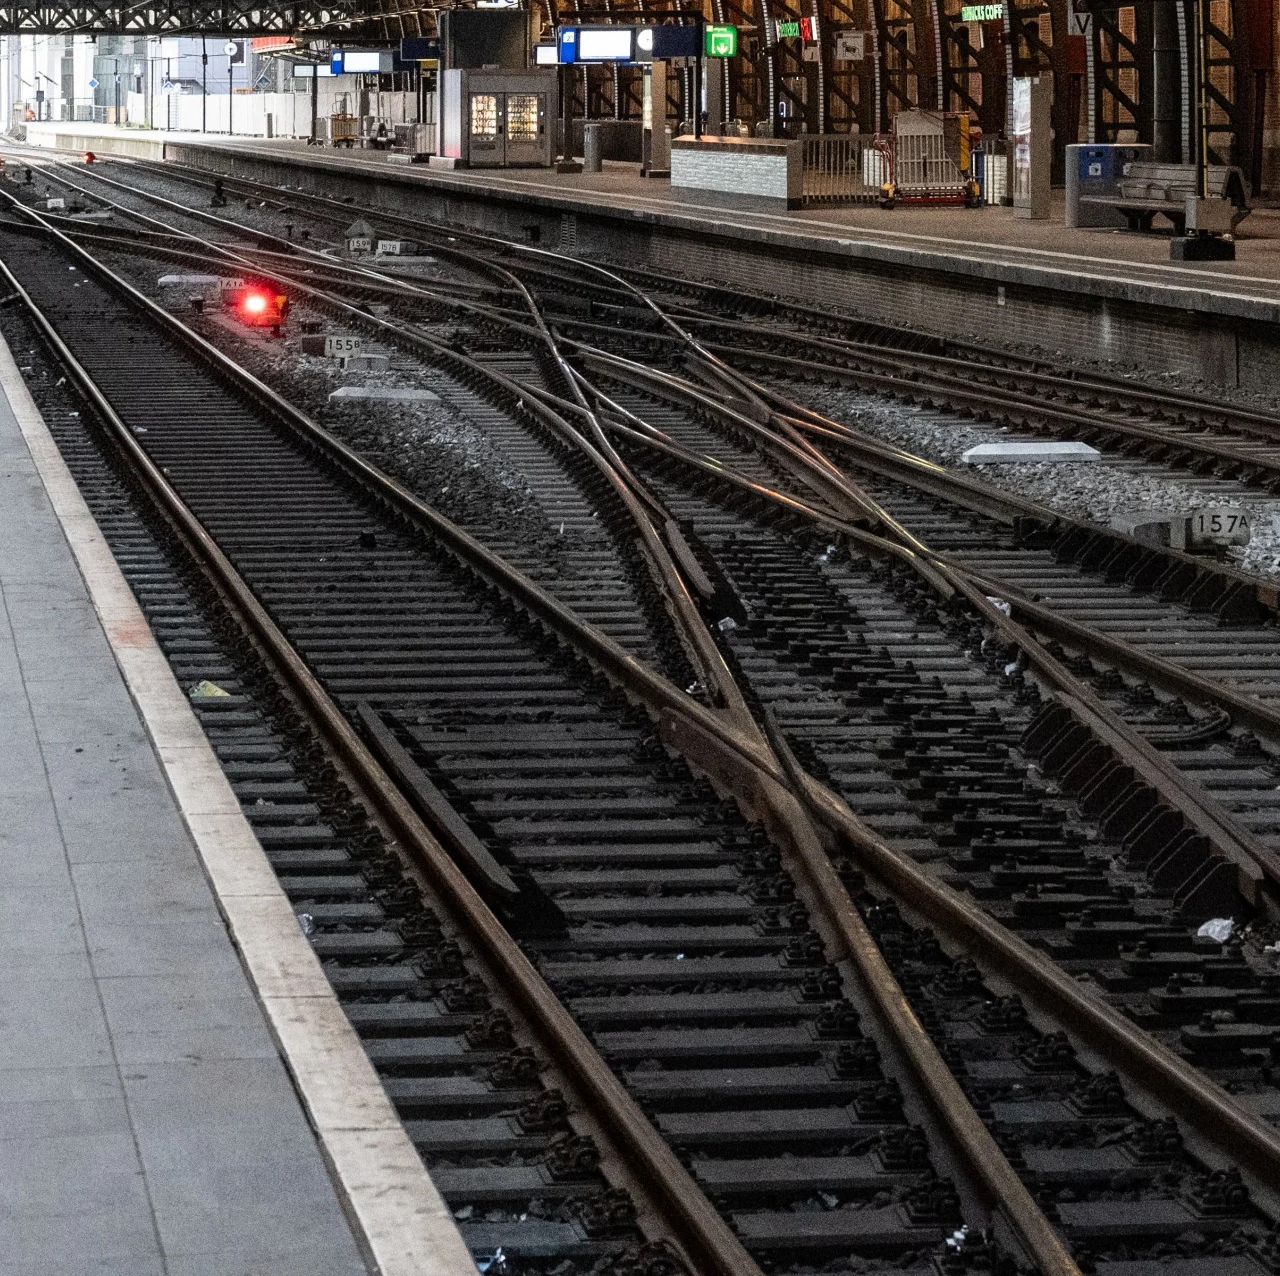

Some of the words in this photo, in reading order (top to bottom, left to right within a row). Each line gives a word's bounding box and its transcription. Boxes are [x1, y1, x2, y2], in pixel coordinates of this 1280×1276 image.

[1075, 15, 1090, 34] V
[329, 340, 360, 350] 155B
[1198, 514, 1248, 532] 157A
